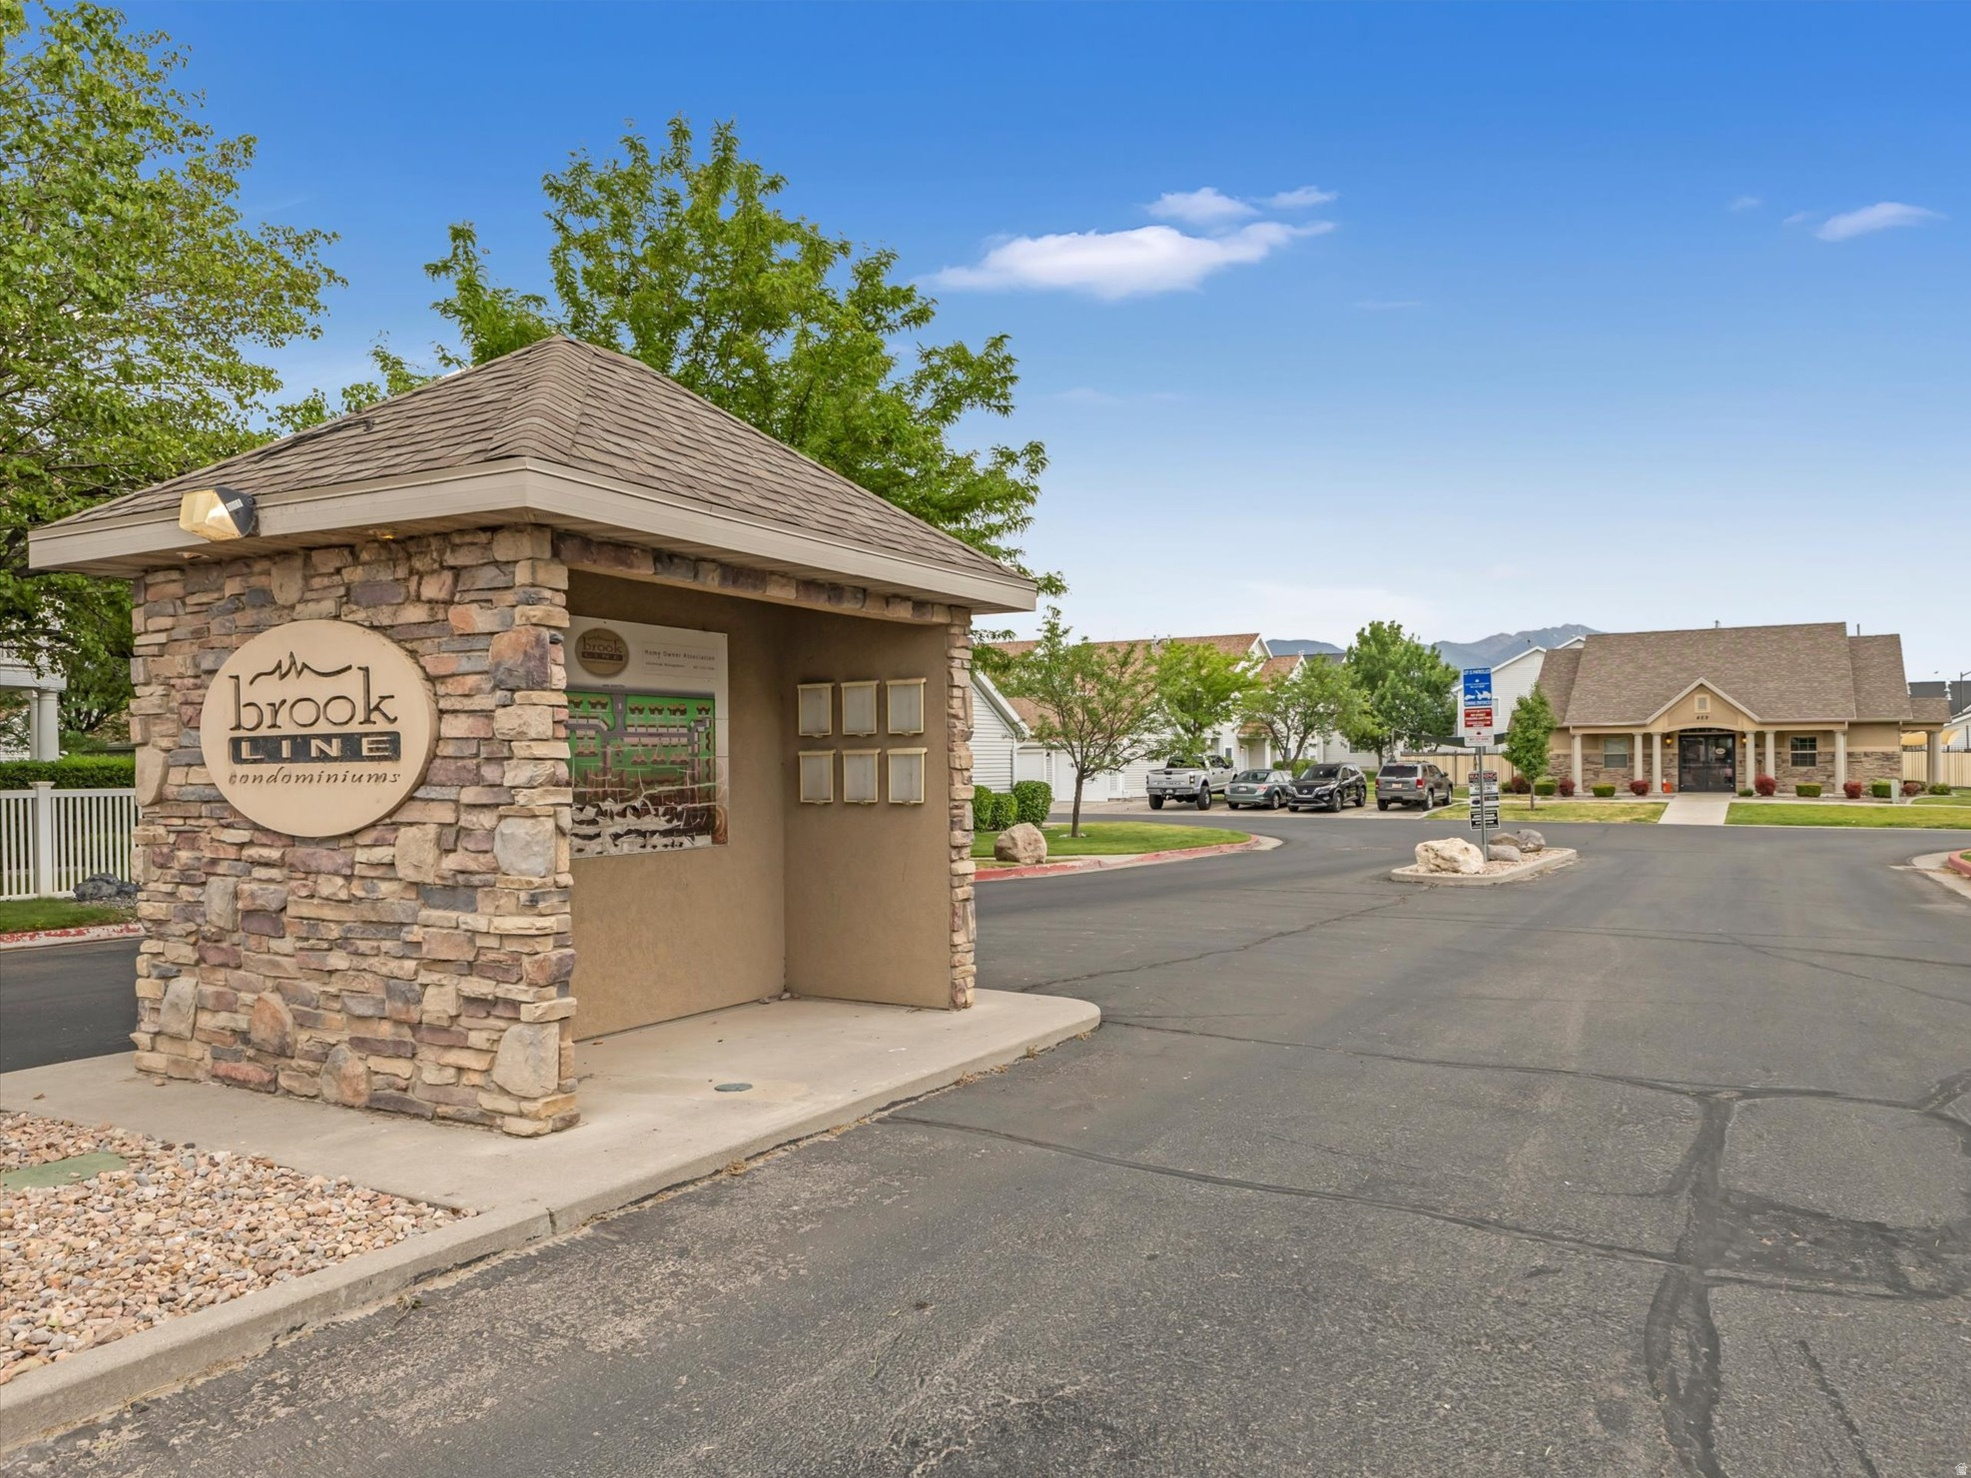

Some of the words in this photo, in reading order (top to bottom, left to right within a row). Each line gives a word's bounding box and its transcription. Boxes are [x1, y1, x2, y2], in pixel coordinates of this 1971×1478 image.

[582, 636, 623, 653] brook
[228, 666, 398, 732] brook
[240, 736, 391, 760] LINE
[228, 766, 400, 786] condominiums
